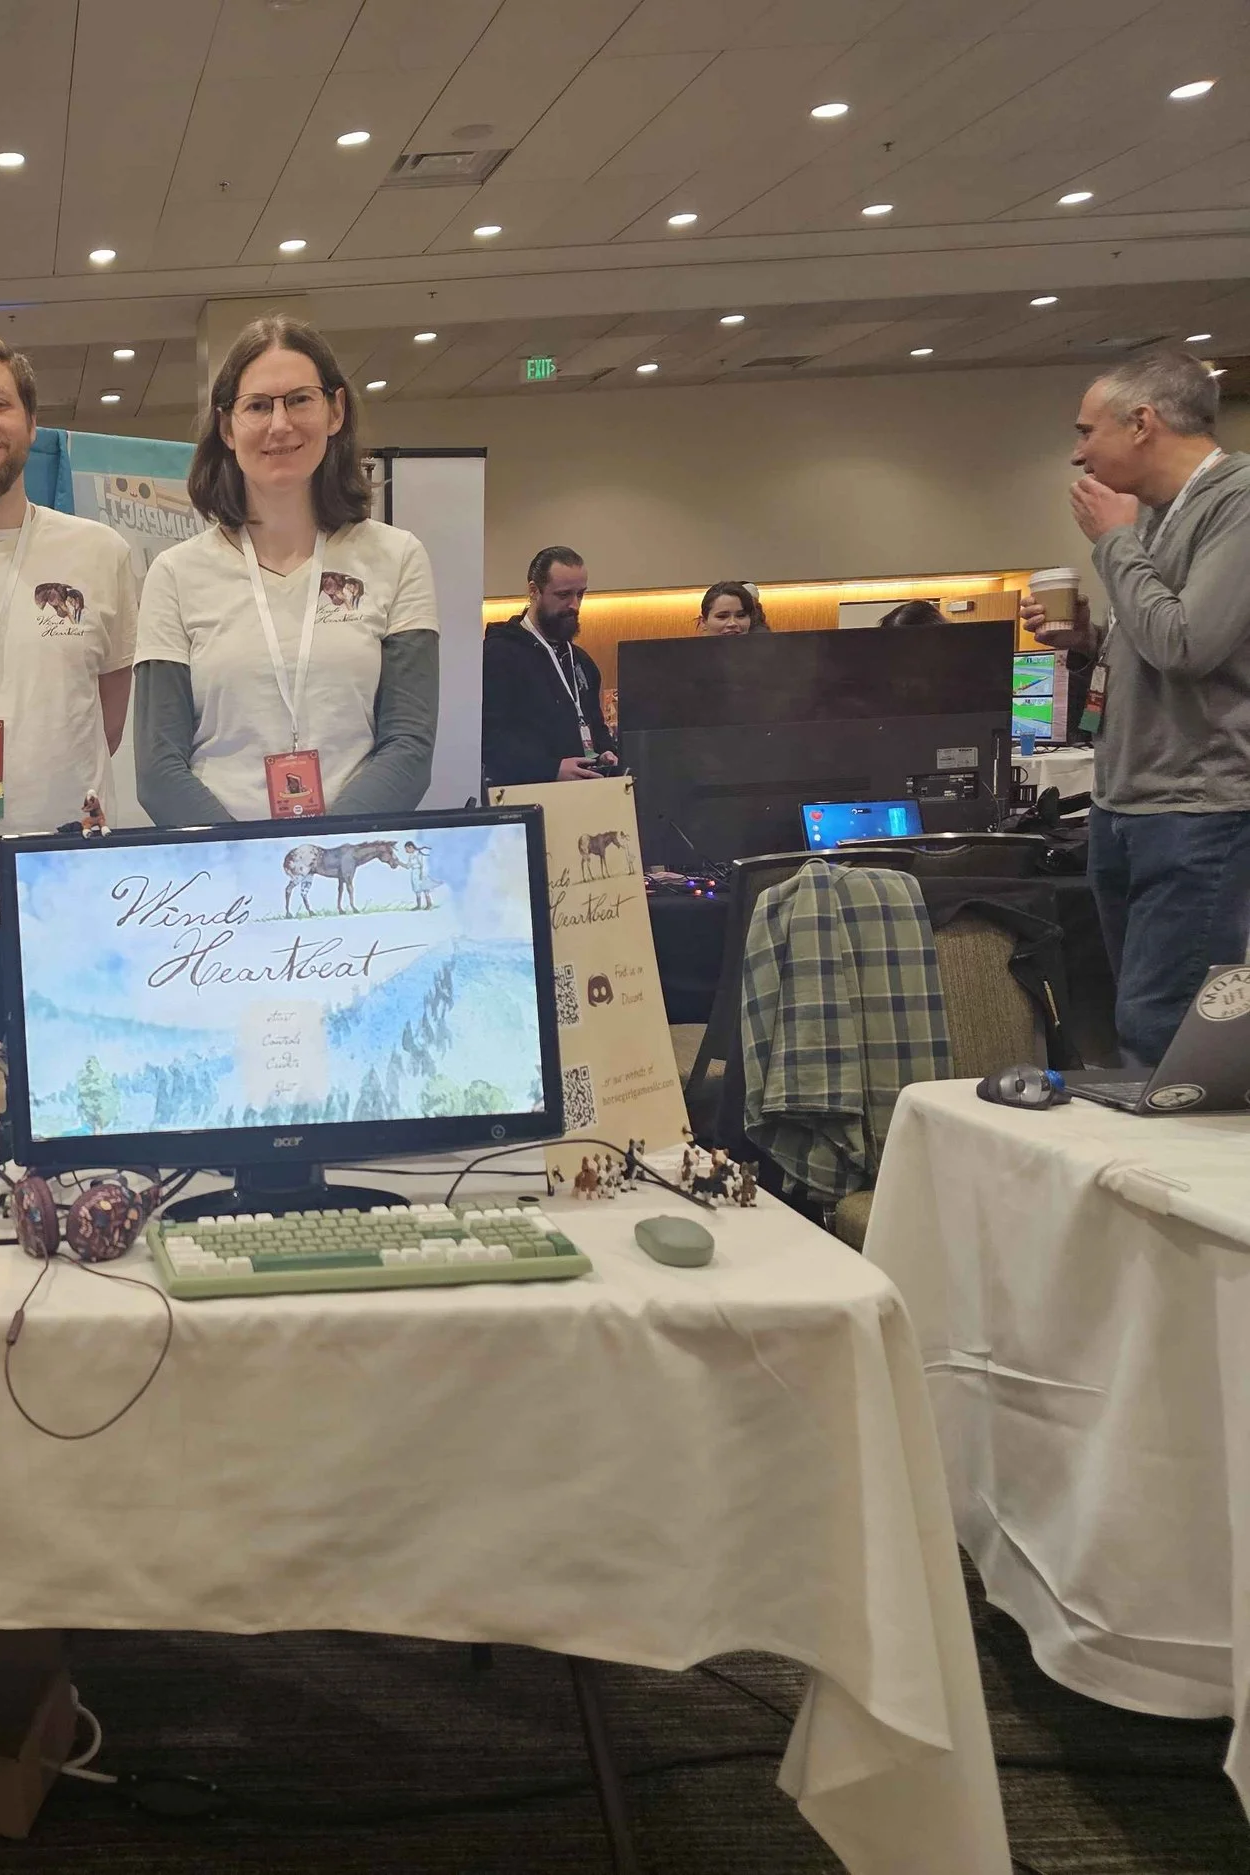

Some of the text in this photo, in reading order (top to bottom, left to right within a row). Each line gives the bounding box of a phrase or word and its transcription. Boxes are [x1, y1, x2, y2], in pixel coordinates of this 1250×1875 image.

[527, 359, 552, 379] EXIT
[112, 870, 253, 927] Wind's
[148, 928, 428, 995] Heartbeat
[273, 1135, 303, 1147] acer
